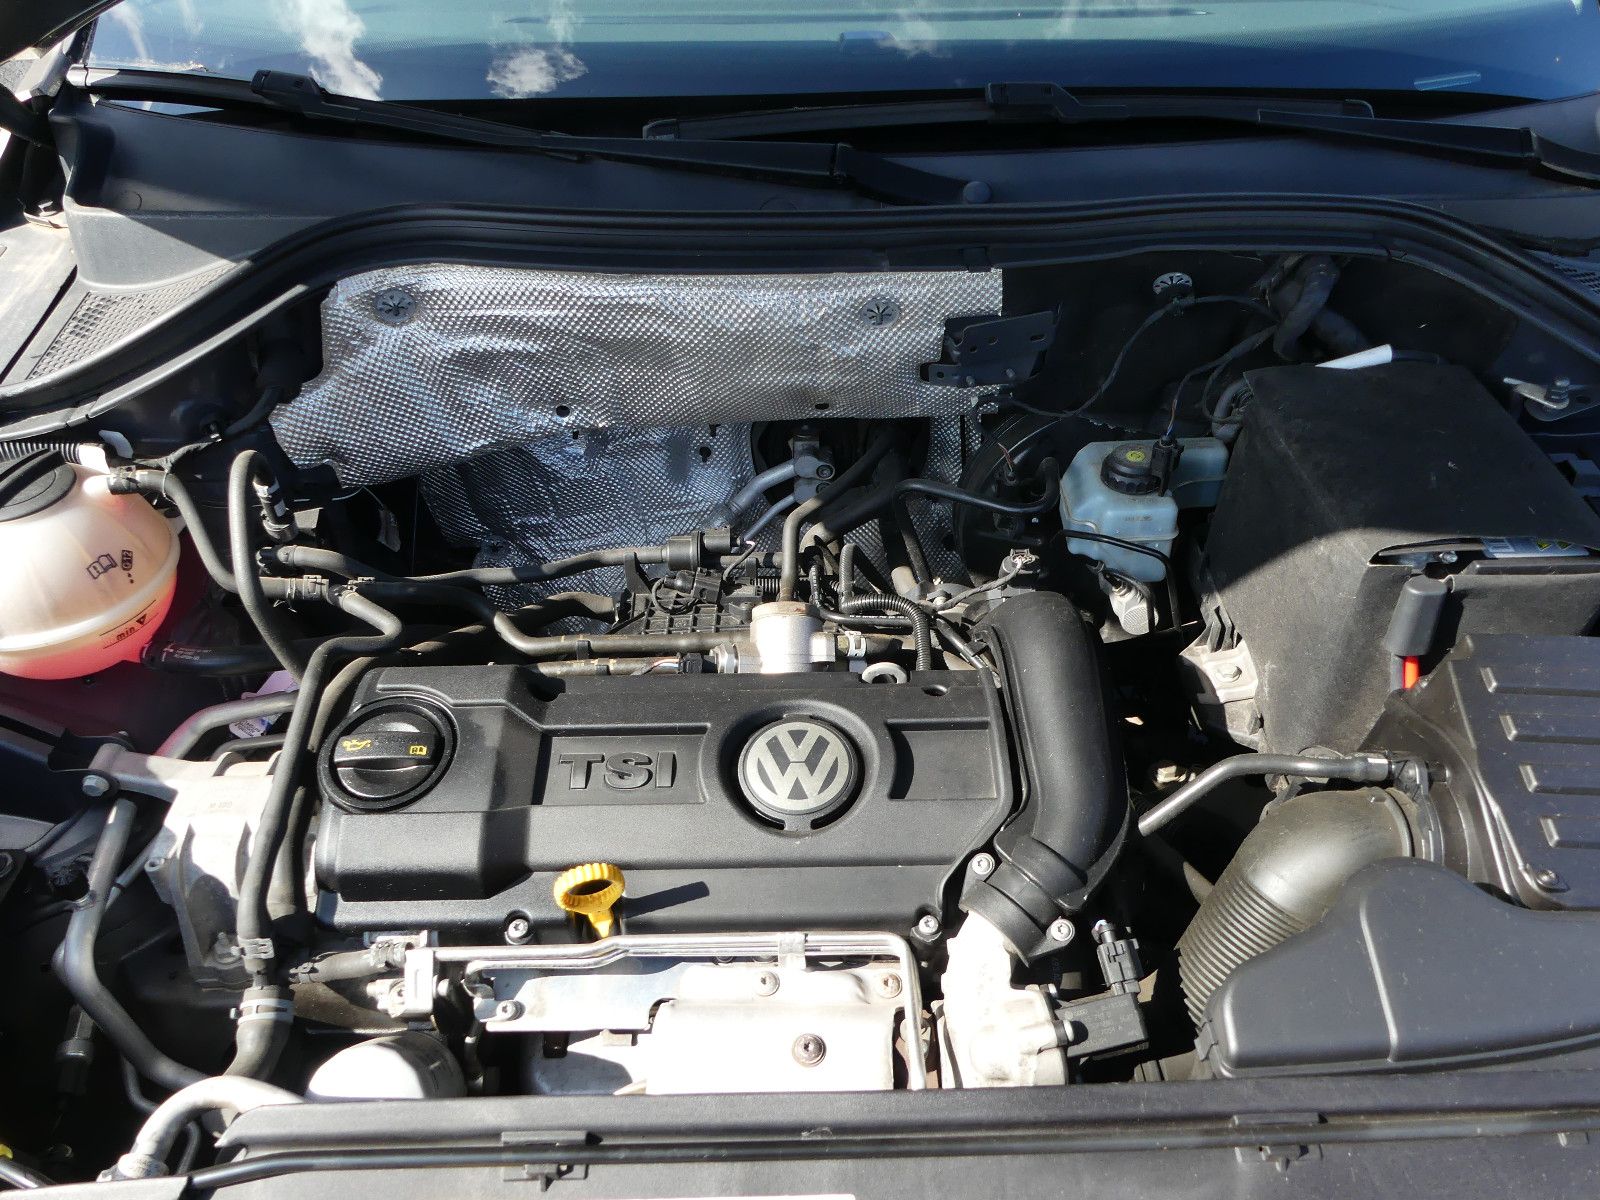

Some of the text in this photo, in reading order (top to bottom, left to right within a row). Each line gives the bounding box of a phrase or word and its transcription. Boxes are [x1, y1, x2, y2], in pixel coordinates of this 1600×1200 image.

[116, 626, 136, 641] min
[559, 751, 677, 790] TSI
[749, 724, 846, 807] VW
